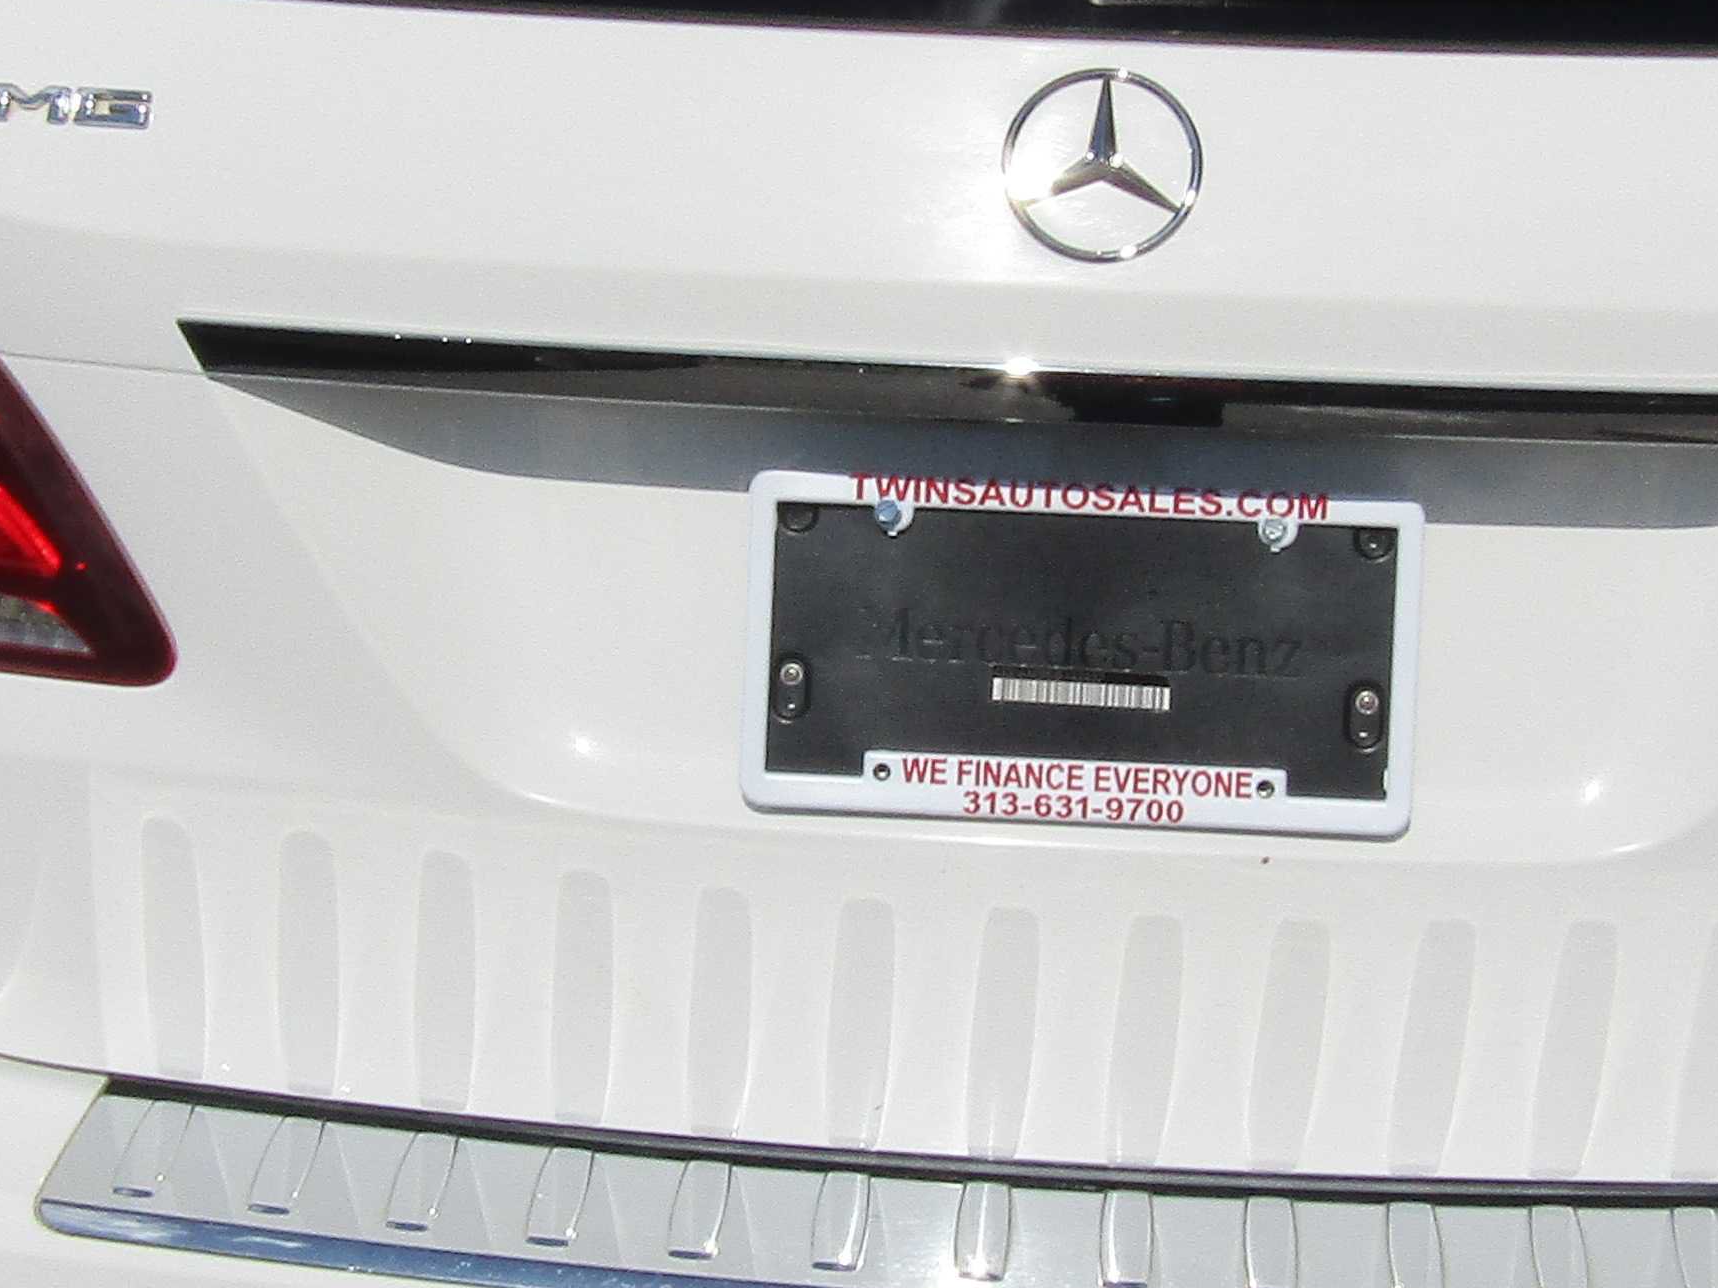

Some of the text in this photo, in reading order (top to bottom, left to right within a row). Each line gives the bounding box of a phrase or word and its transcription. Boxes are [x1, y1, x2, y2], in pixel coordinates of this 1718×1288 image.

[849, 472, 1330, 520] TWINSAUTOSALES.COM
[902, 758, 1253, 800] WE FINANCE EVERYONE
[963, 790, 1185, 825] 313-631-9700
